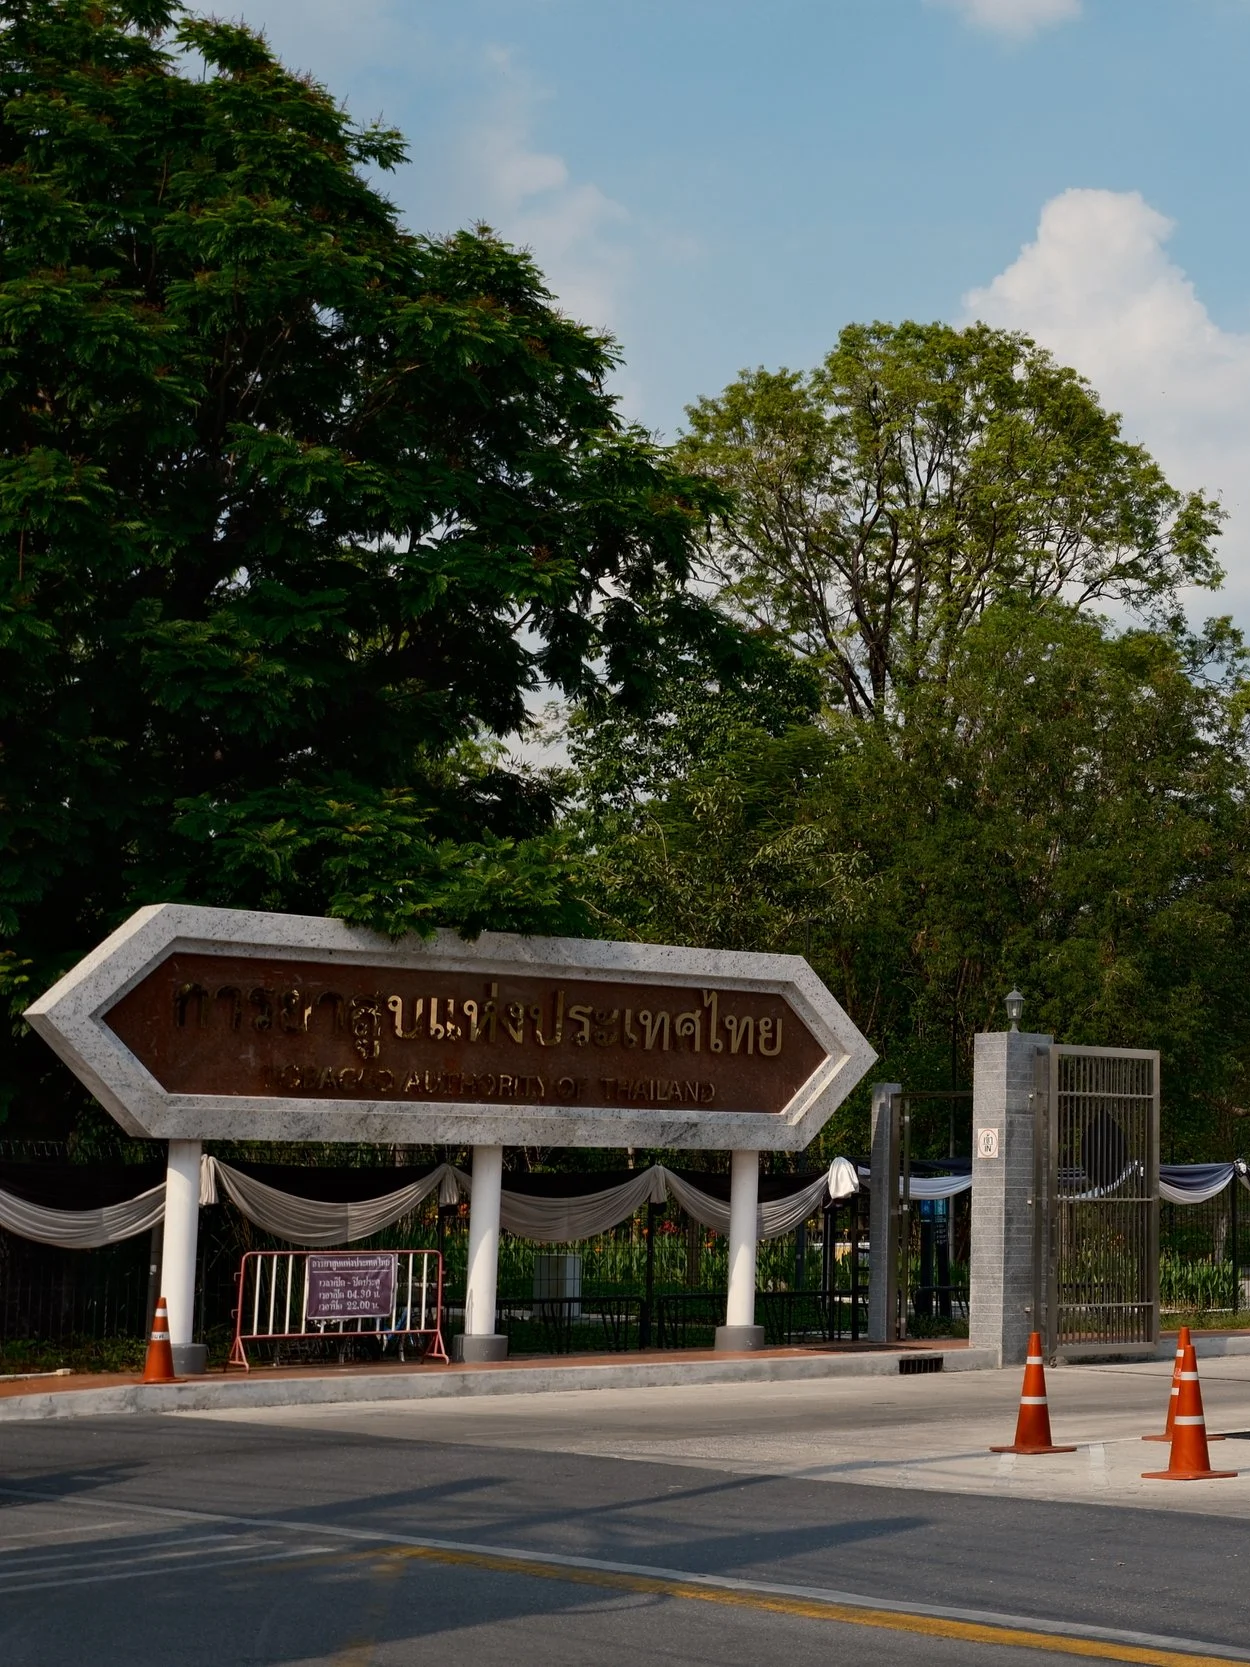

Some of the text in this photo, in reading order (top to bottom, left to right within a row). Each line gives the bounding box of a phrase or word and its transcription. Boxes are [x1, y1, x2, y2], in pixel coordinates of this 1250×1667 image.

[174, 981, 784, 1060] การยาสูบแห่งประเทศไทย
[601, 1077, 715, 1103] THAILAND
[346, 1301, 370, 1310] 22.00
